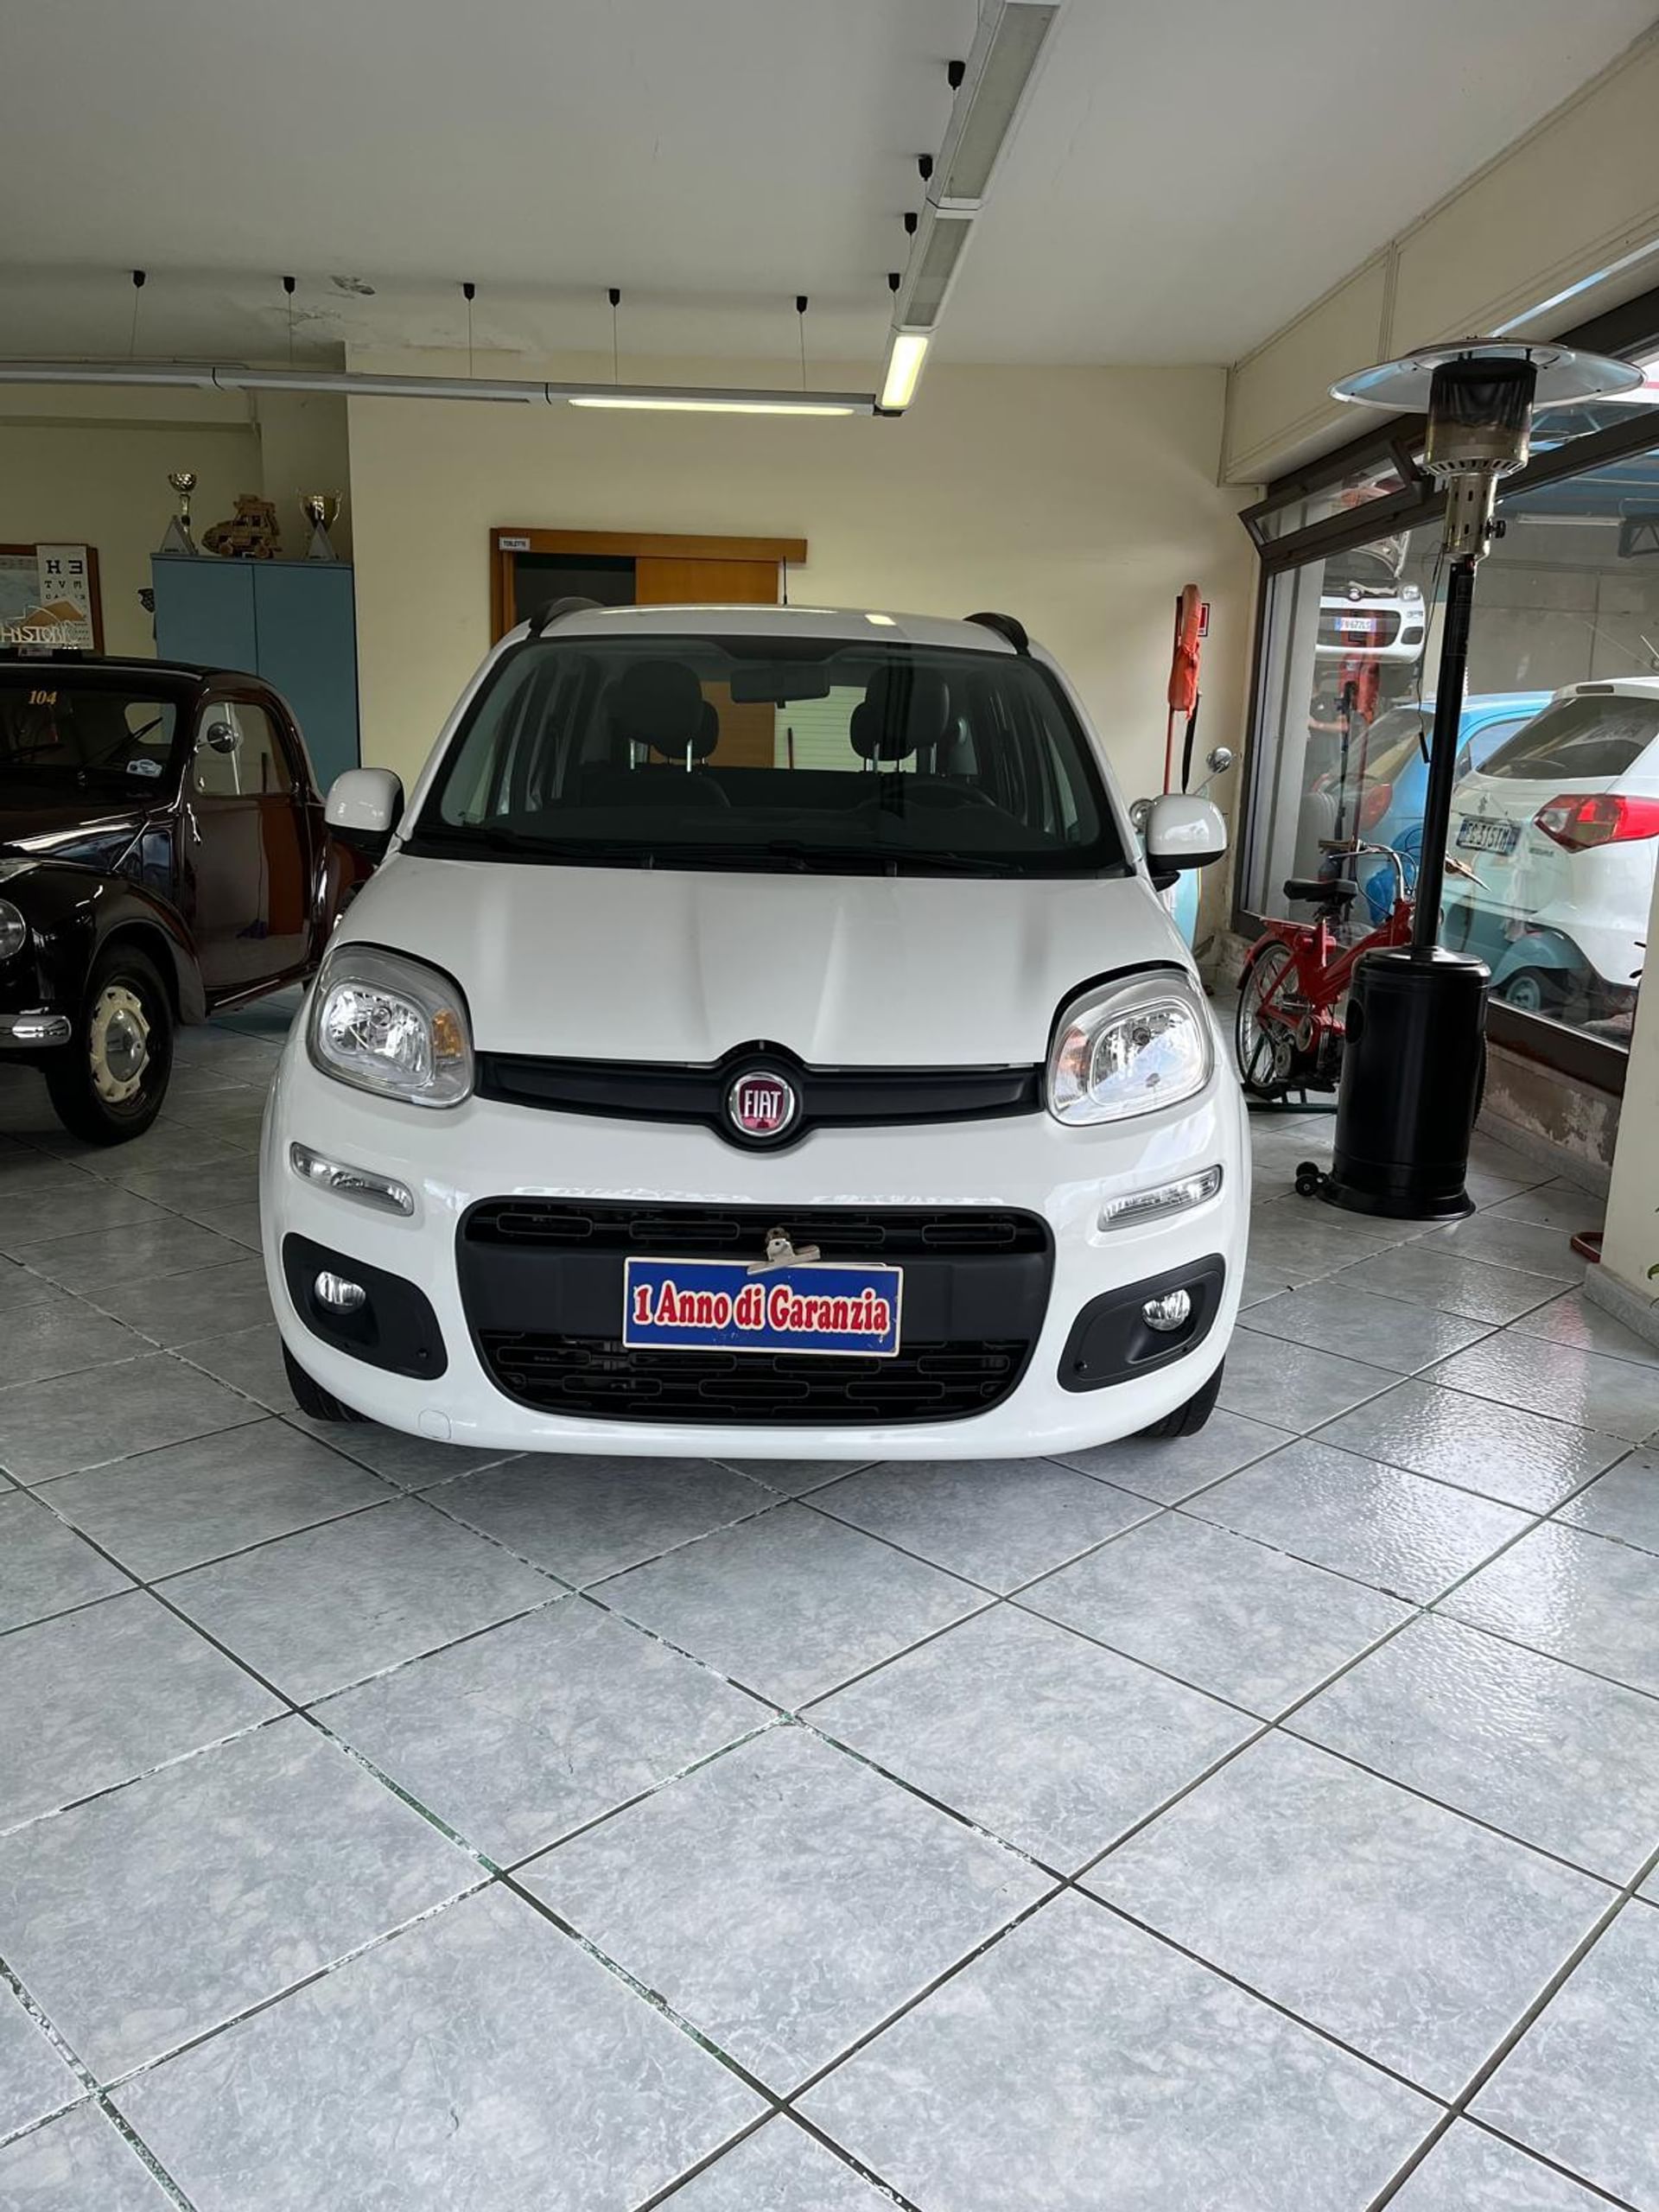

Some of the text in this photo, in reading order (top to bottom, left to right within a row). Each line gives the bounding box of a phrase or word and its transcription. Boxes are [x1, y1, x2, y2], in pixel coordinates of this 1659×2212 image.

[28, 690, 58, 705] 104
[744, 1089, 782, 1119] FIAT
[634, 1282, 889, 1332] 1 Anno di Garanzia
